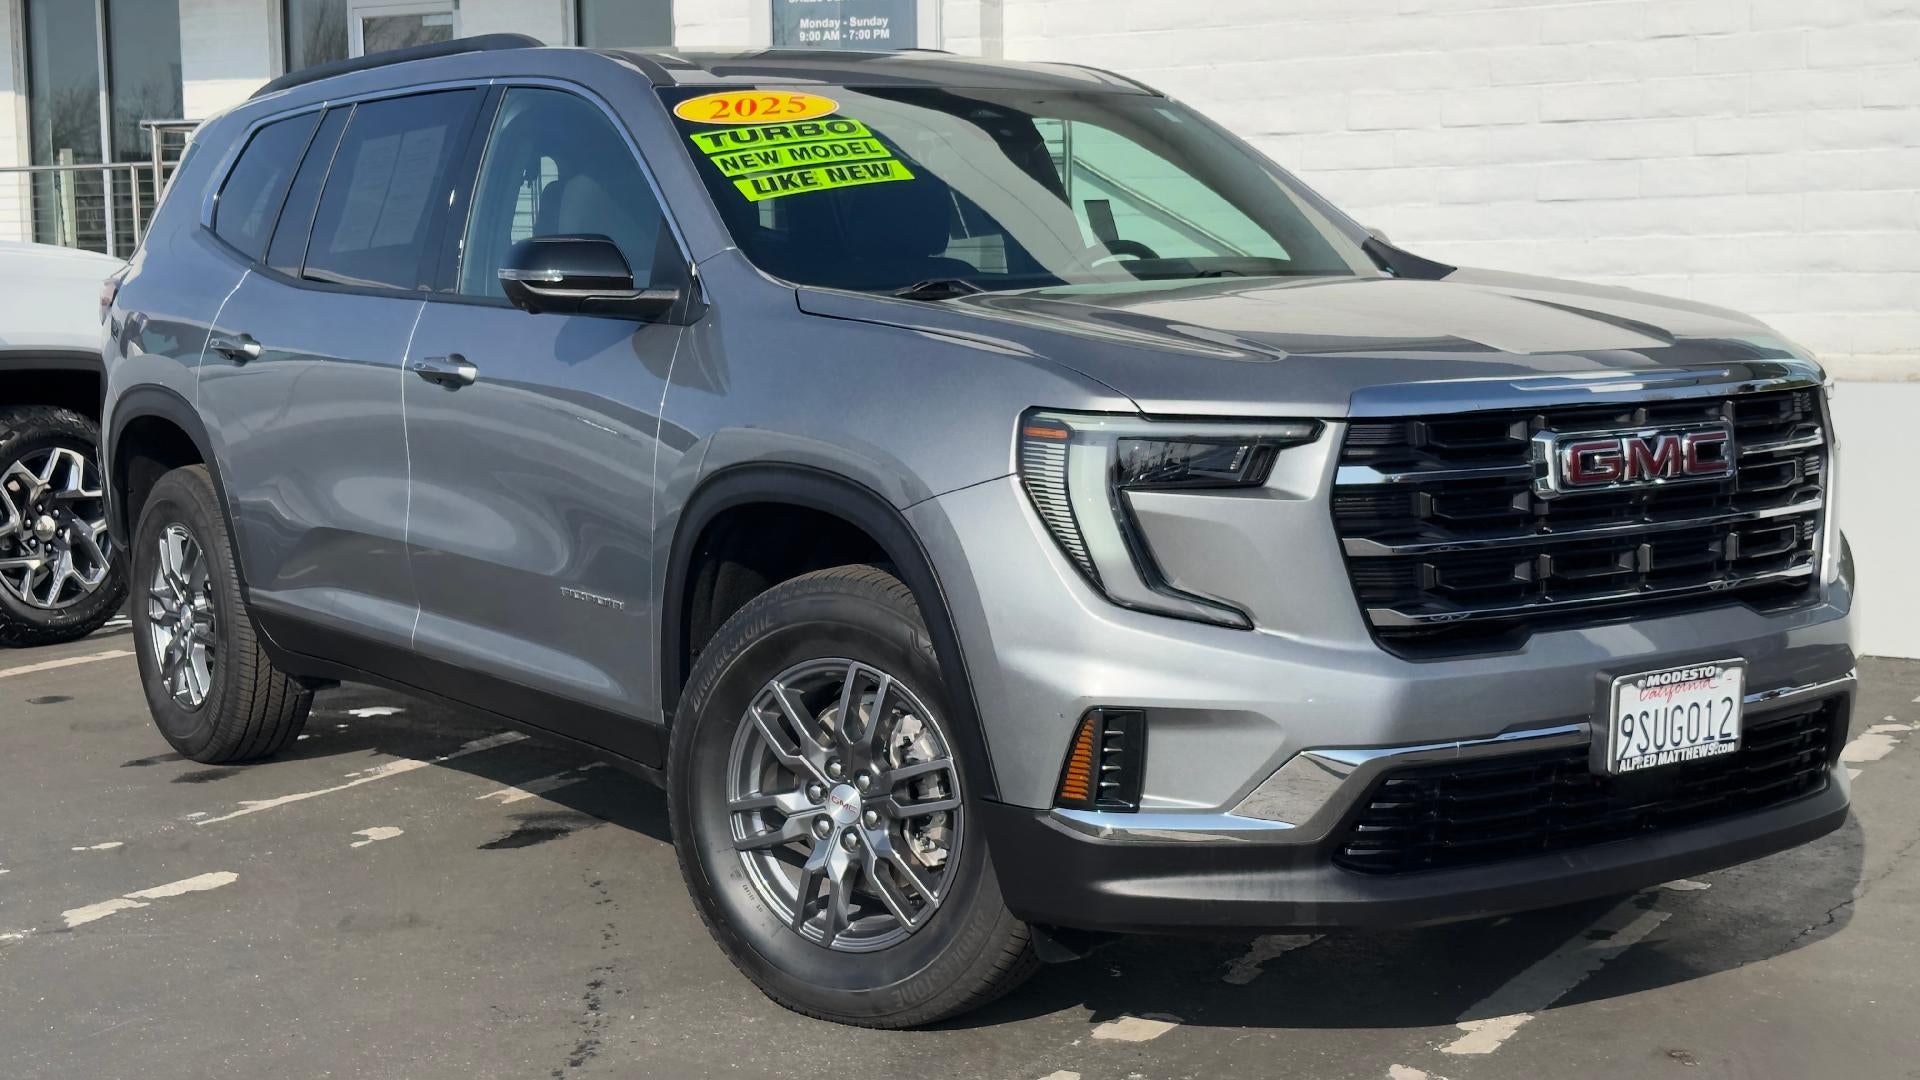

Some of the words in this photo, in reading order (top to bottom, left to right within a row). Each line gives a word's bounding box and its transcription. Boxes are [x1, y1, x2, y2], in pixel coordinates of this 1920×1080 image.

[799, 31, 821, 42] 9:00
[822, 30, 841, 41] AM
[848, 29, 871, 40] 7:00
[873, 29, 890, 39] PM
[800, 18, 840, 30] Monday
[849, 16, 889, 28] Sunday
[709, 95, 807, 120] 2025
[700, 120, 858, 149] TURBO
[720, 150, 780, 173] NEW
[790, 140, 881, 162] MODEL
[750, 170, 819, 195] LIKE
[828, 162, 891, 183] NEW
[1565, 431, 1729, 486] GMC
[1646, 666, 1716, 688] MODESTO
[1619, 696, 1734, 760] 9SUG012
[830, 795, 858, 814] GMC
